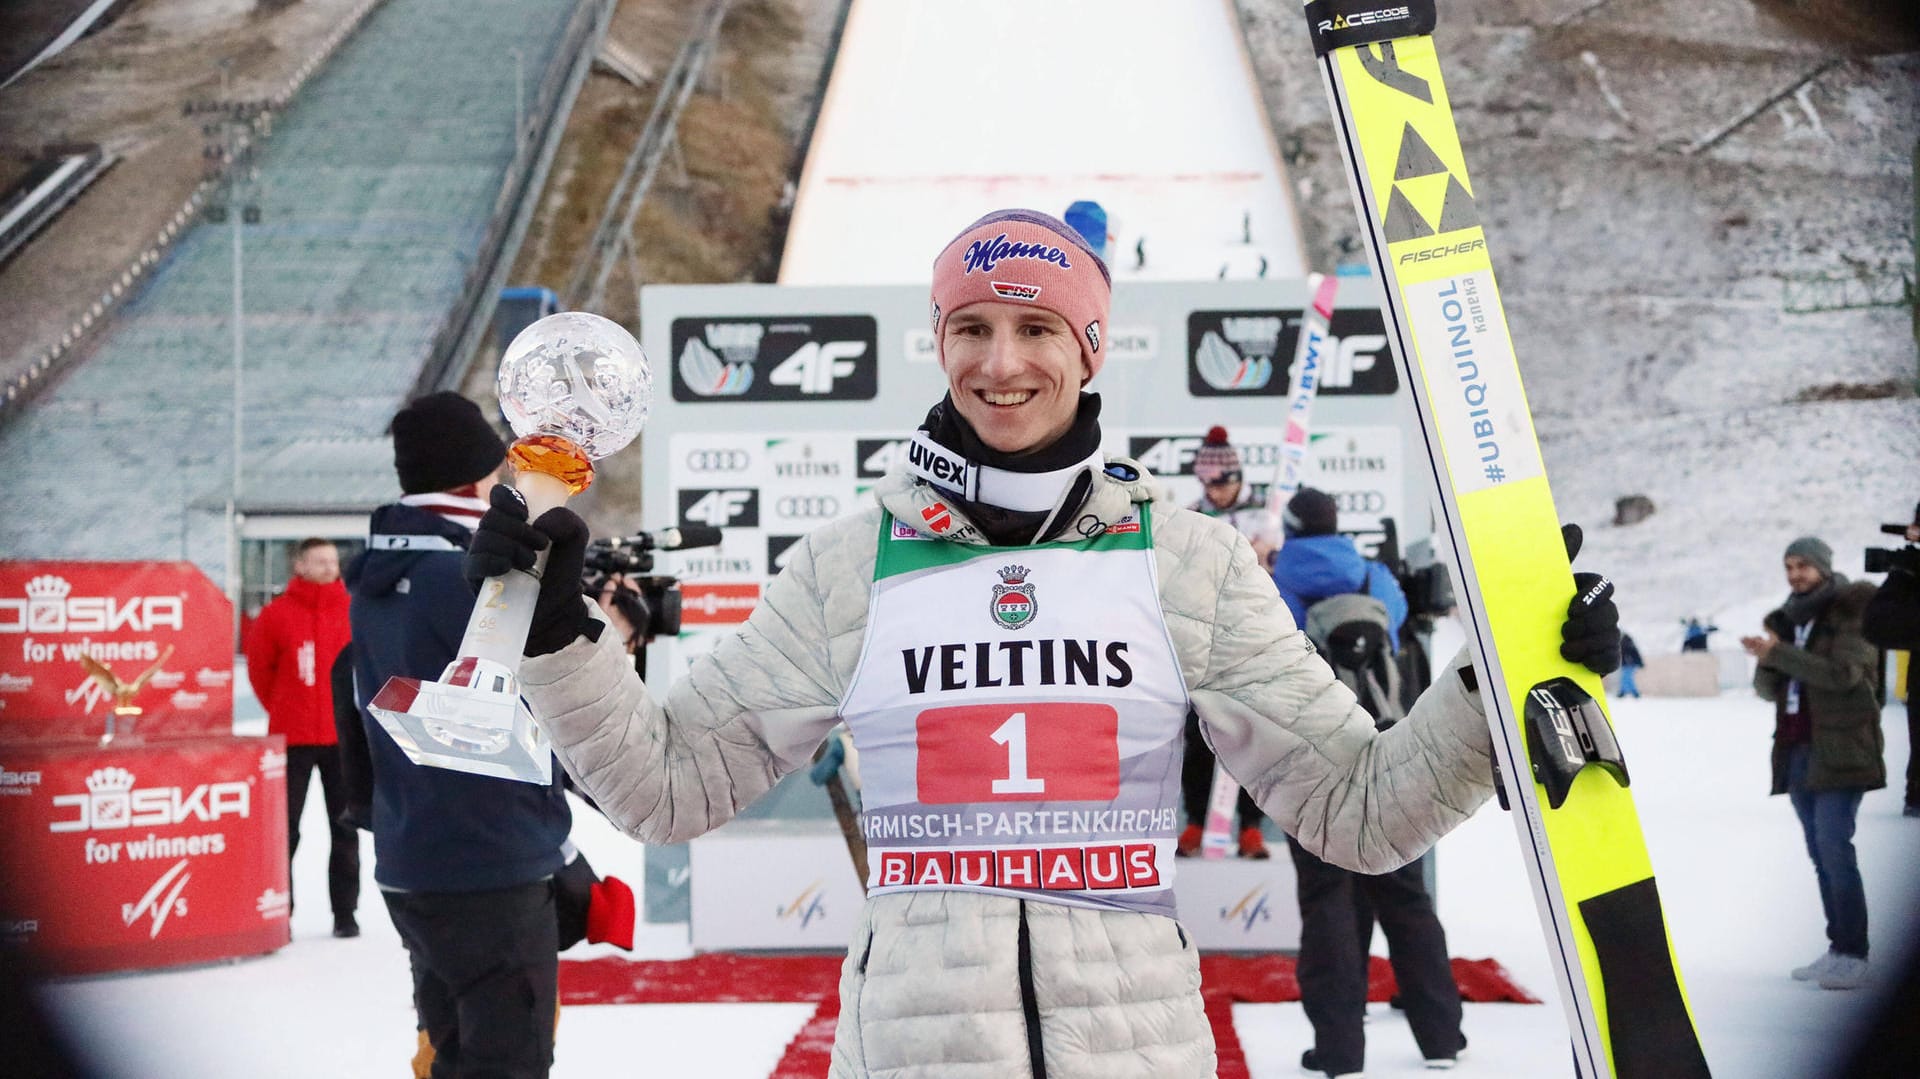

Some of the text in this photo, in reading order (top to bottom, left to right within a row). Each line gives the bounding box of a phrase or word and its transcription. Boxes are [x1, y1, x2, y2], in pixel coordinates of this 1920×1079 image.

[963, 233, 1072, 275] Manner
[1400, 239, 1485, 266] FISCHER
[1463, 277, 1487, 334] kaneka
[769, 341, 868, 394] 4F
[1438, 279, 1506, 483] #UBIQUINOL
[908, 440, 965, 487] uvex
[1318, 457, 1386, 472] VELTINS
[685, 490, 751, 526] 4F
[23, 637, 158, 662] for winners
[902, 639, 1134, 694] VELTINS
[990, 712, 1046, 795] 1
[85, 832, 226, 864] for winners
[884, 850, 1152, 886] BAUHAUS
